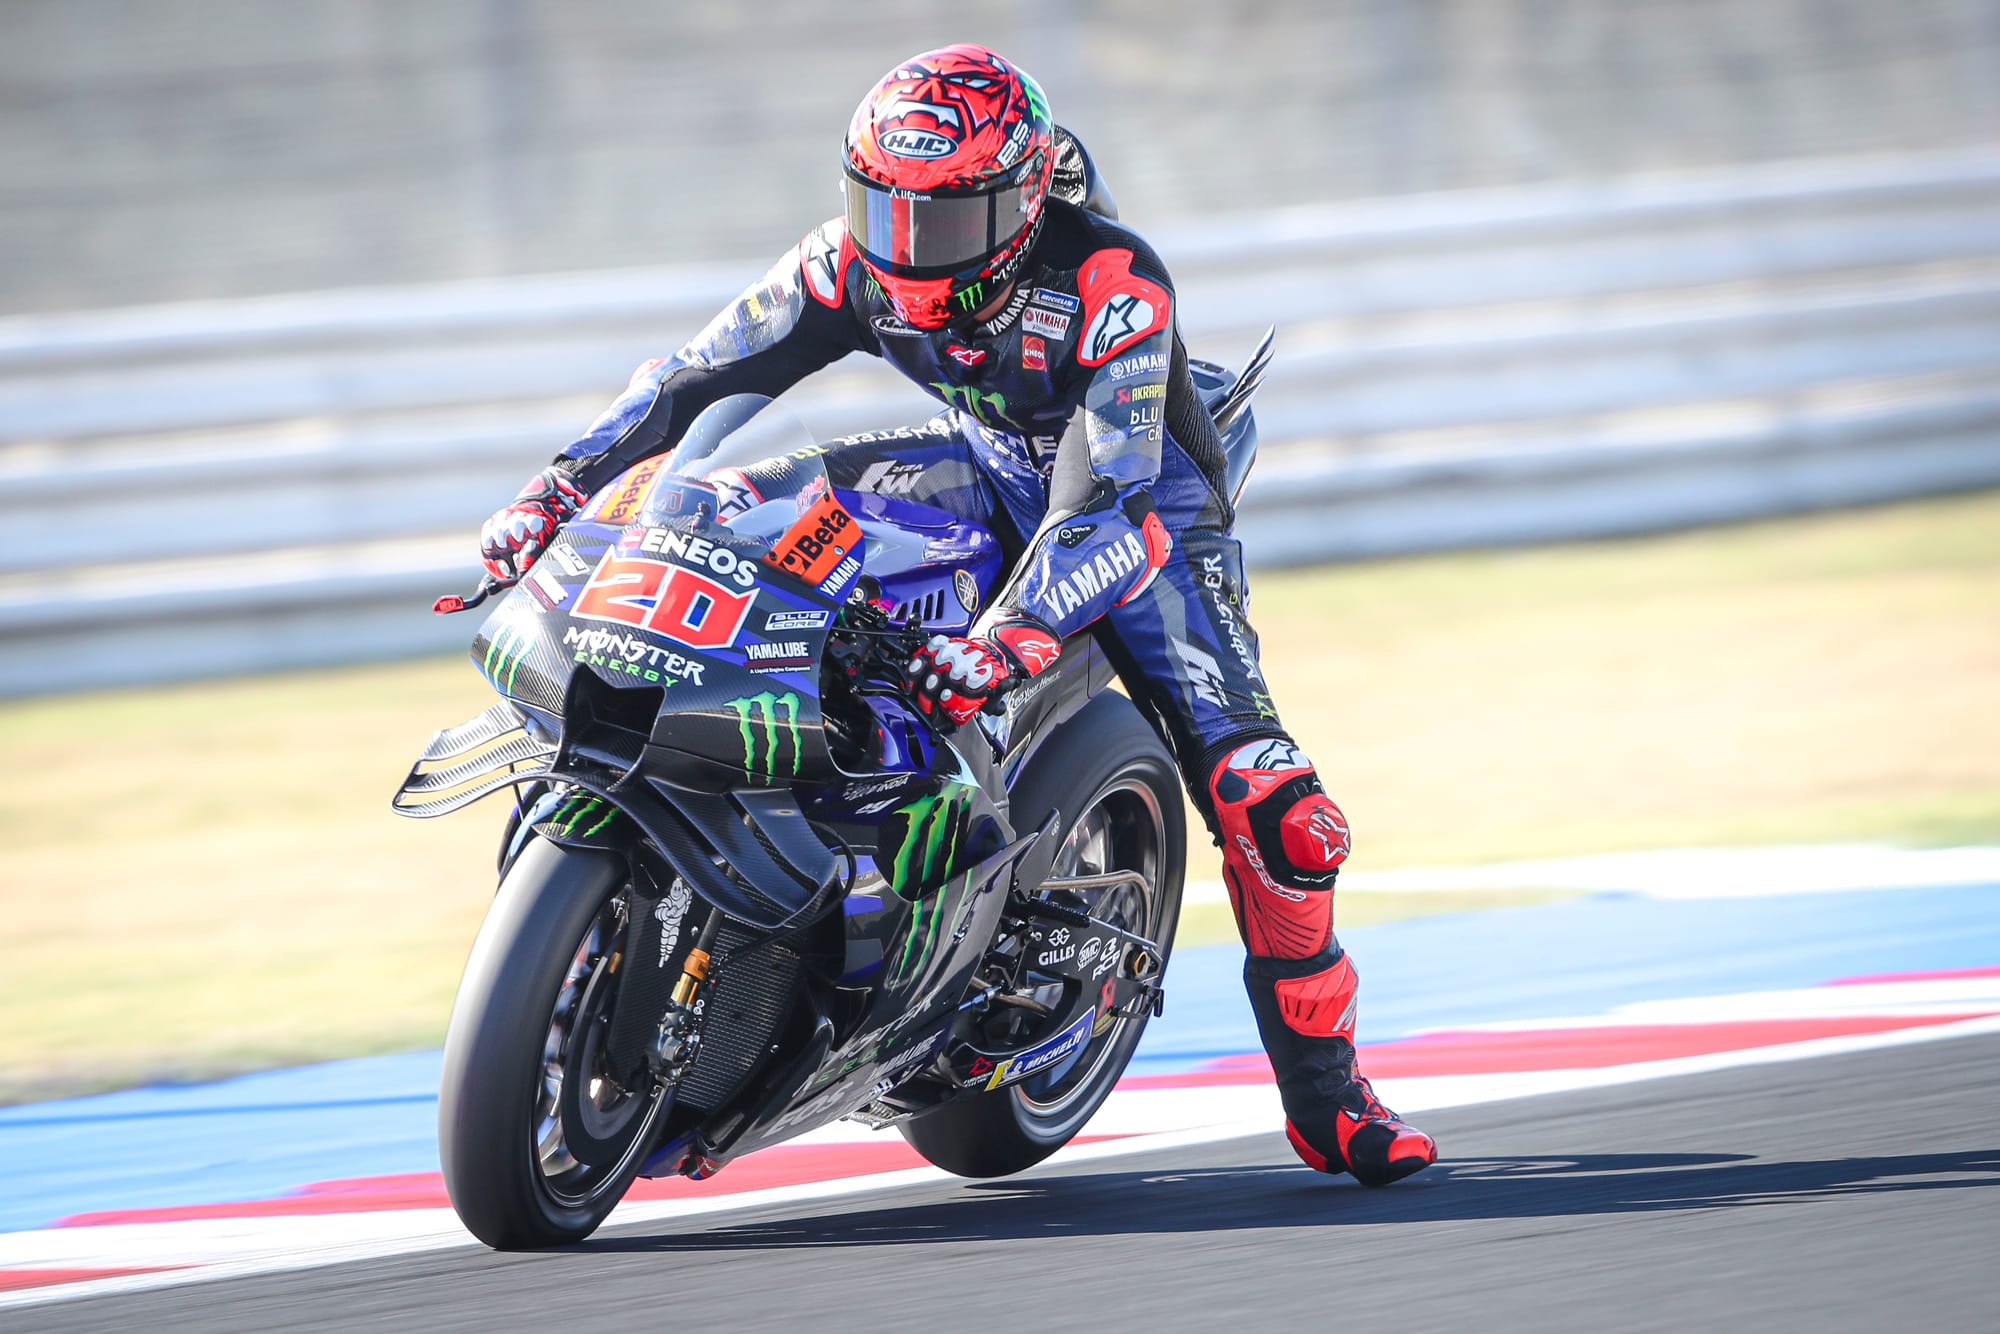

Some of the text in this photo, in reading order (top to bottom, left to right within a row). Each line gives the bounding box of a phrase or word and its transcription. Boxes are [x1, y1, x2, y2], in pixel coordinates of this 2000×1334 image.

[887, 135, 947, 152] HJC
[986, 288, 1030, 335] YAMAHA
[1035, 311, 1067, 330] YAMAHA
[1123, 353, 1167, 374] YAMAH
[794, 508, 852, 561] Beta
[640, 528, 758, 587] ENEOS
[820, 556, 862, 597] YAMAHA
[1043, 532, 1147, 621] YAMAHA
[569, 544, 761, 649] 20
[774, 611, 823, 621] BLUE
[1203, 553, 1257, 679] MONSTER
[772, 620, 819, 629] CORE
[563, 626, 706, 687] MONSTER
[574, 652, 680, 688] ENERGY
[745, 641, 809, 660] YAMALUBE
[1038, 943, 1076, 966] GILLES
[1024, 1027, 1085, 1071] MICHELIN
